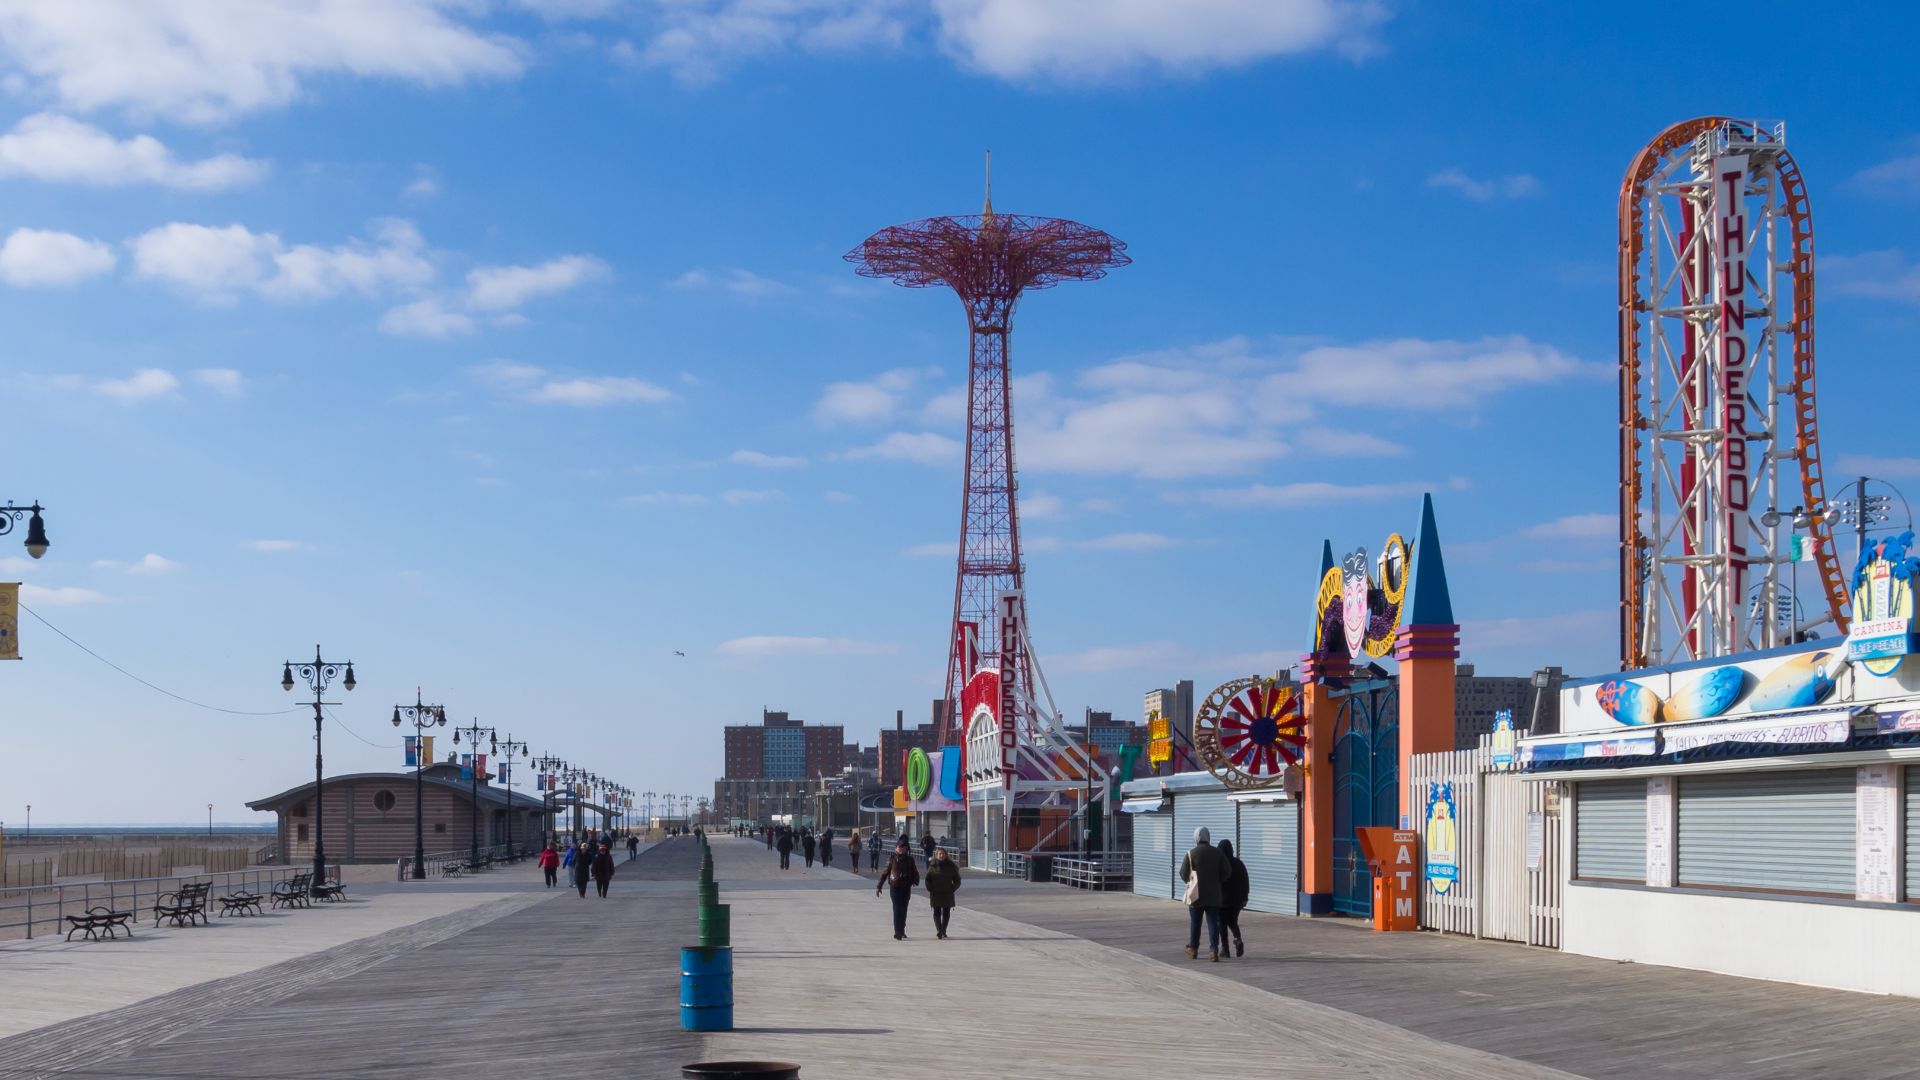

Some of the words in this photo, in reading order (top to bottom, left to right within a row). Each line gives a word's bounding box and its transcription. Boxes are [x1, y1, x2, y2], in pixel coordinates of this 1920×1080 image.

[1722, 171, 1748, 605] THUNDERBOLT
[1001, 596, 1018, 790] THUNDERBOLT
[1854, 620, 1904, 637] CANTINA
[1396, 845, 1412, 917] ATM
